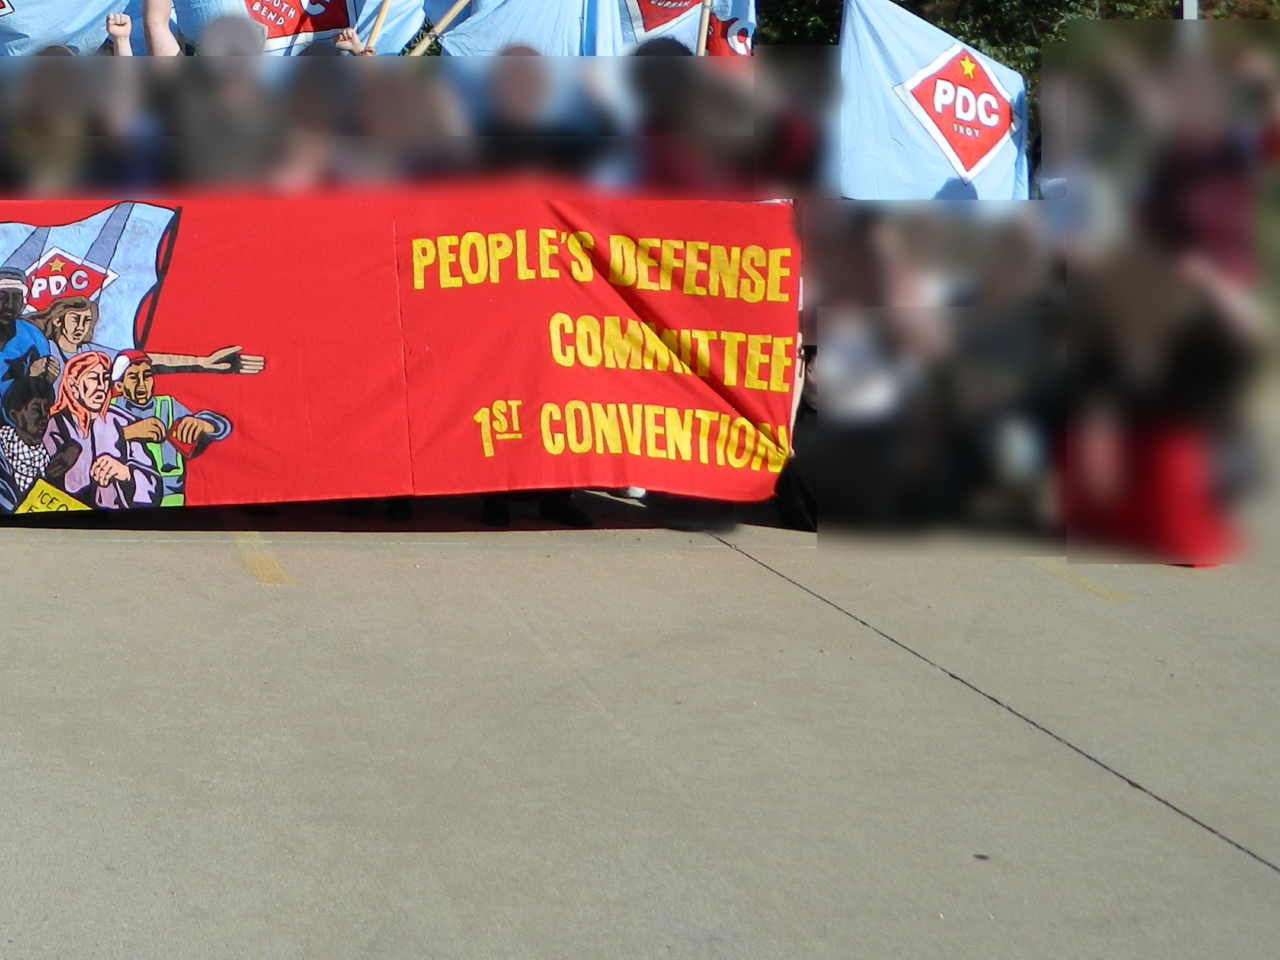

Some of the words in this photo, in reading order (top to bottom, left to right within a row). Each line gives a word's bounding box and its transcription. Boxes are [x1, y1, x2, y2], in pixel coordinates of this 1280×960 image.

[252, 1, 286, 26] BEND
[933, 78, 1001, 128] PDC
[952, 122, 980, 138] TROY
[31, 270, 89, 299] PDC
[412, 228, 595, 290] PEOPLE'S
[608, 234, 792, 304] DEFENSE
[549, 312, 794, 393] COMMITTEE
[473, 400, 523, 458] 1ST
[540, 400, 791, 474] CONVENTION
[37, 489, 60, 510] ICE
